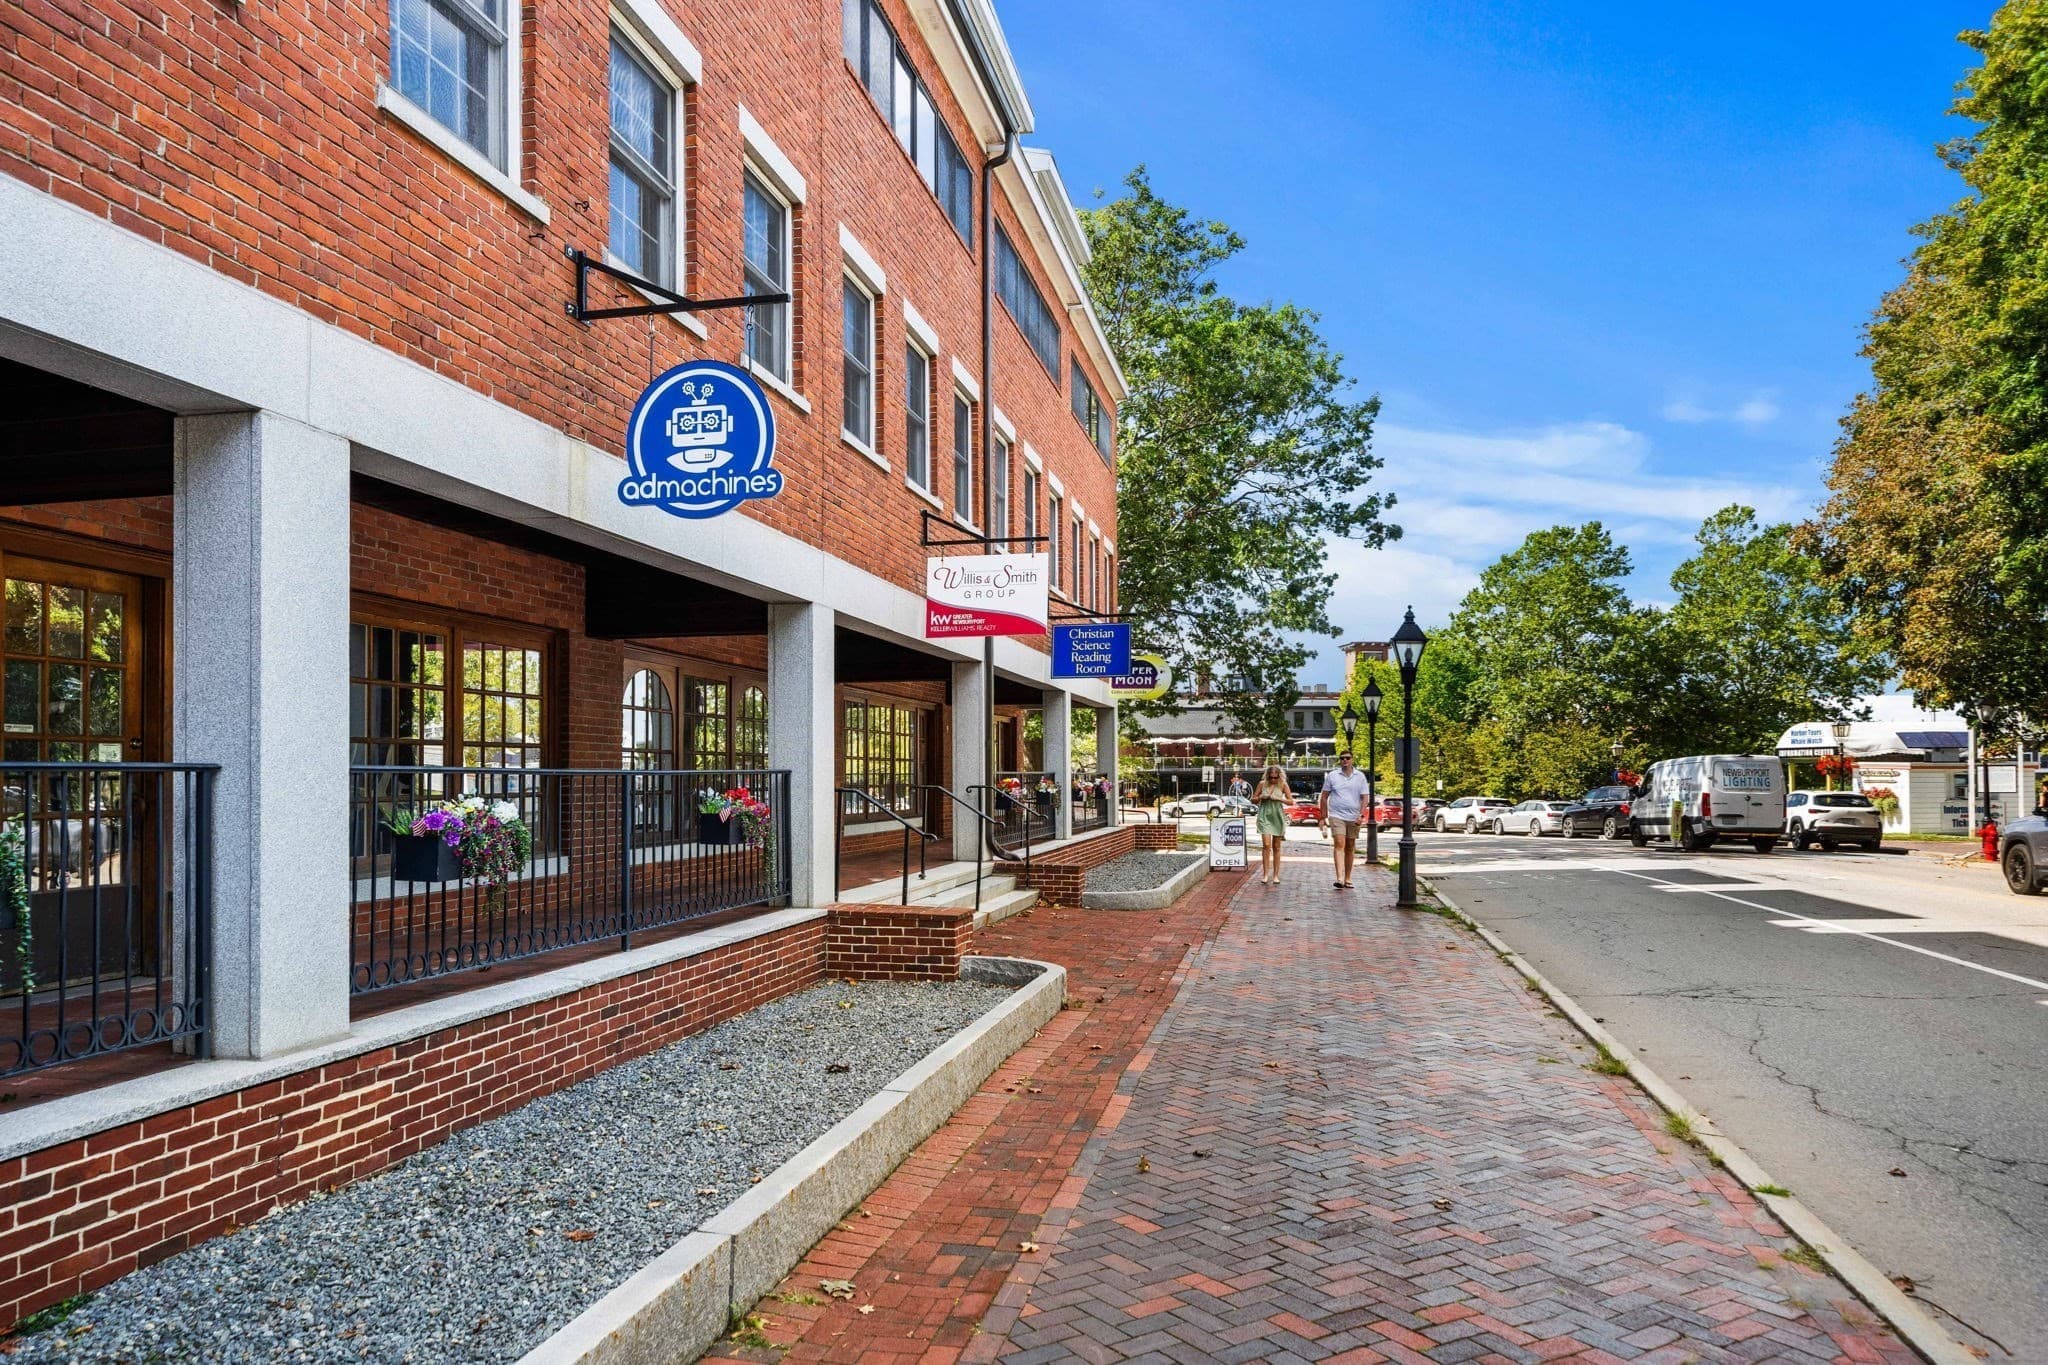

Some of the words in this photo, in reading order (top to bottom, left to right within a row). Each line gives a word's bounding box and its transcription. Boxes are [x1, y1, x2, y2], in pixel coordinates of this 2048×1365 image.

[623, 469, 777, 500] admachines
[933, 566, 983, 590] Willis
[984, 575, 991, 584] &
[993, 564, 1037, 589] Smith
[963, 589, 1016, 599] GROUP
[930, 611, 952, 626] kw
[1068, 628, 1115, 640] Christian
[1071, 640, 1111, 651] Science
[1071, 652, 1112, 664] Reading
[1075, 663, 1106, 674] Room
[1131, 666, 1153, 675] PER
[1115, 676, 1152, 685] MOON
[1722, 768, 1770, 777] NEWBURYPORT
[1722, 777, 1771, 787] LIGHTING
